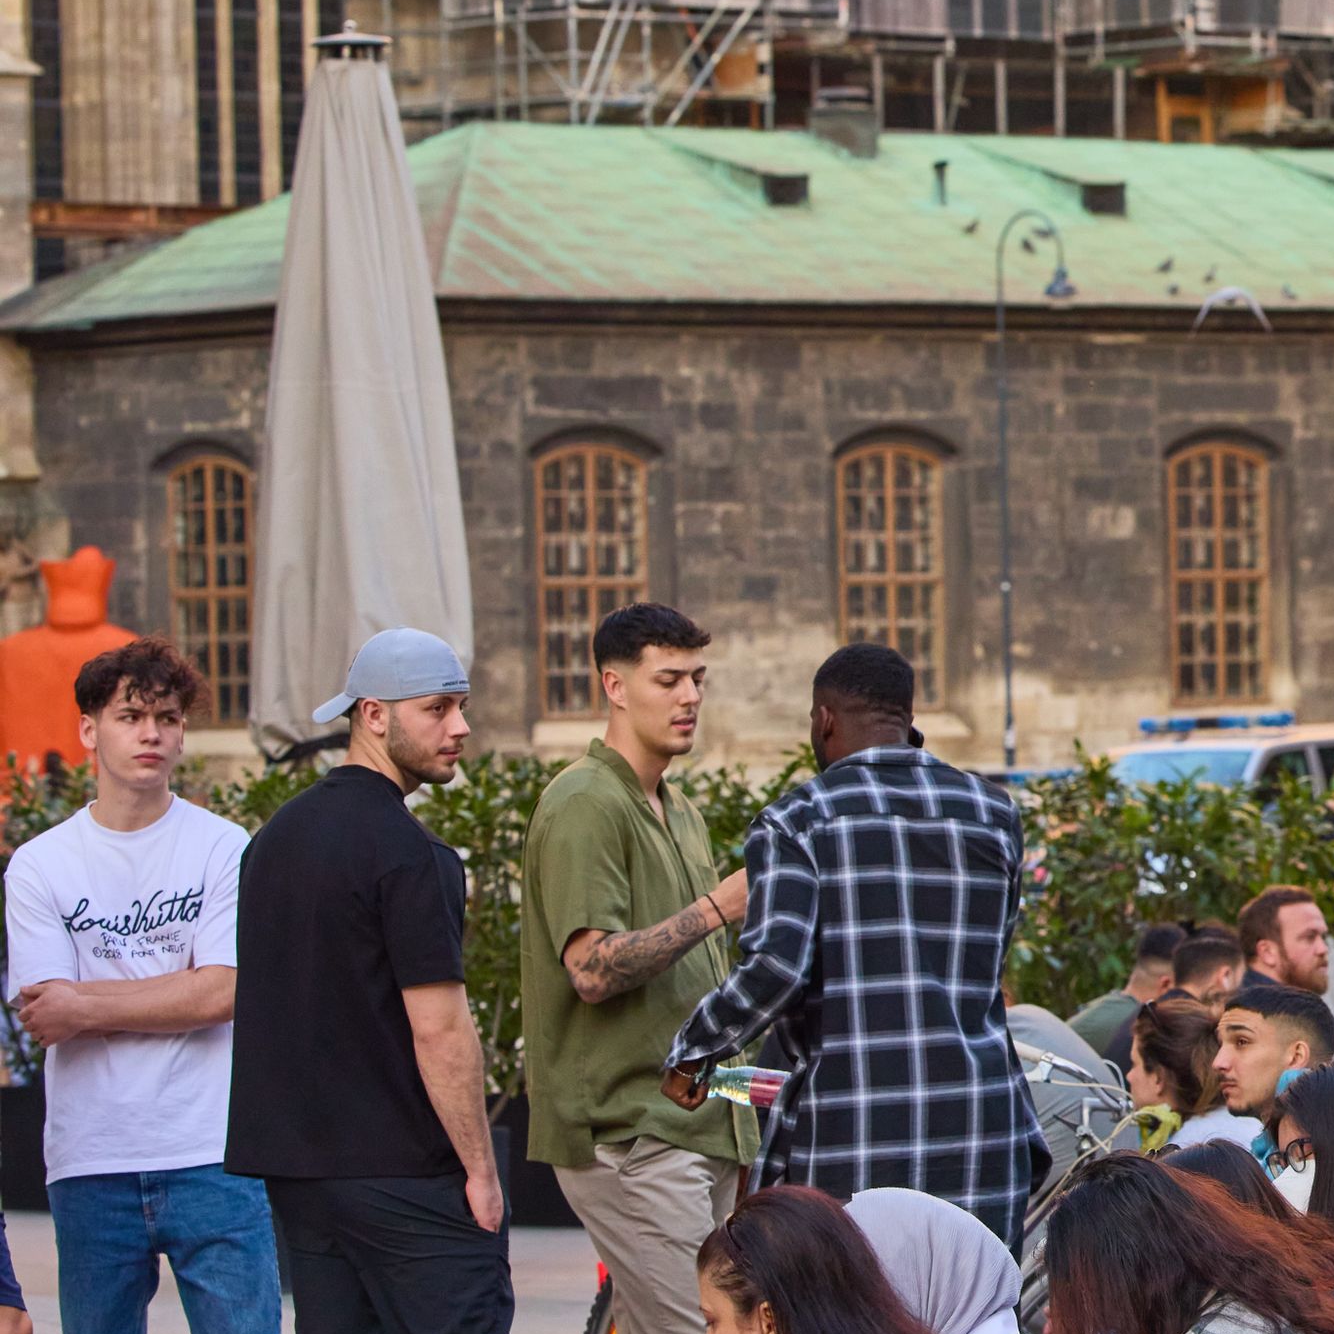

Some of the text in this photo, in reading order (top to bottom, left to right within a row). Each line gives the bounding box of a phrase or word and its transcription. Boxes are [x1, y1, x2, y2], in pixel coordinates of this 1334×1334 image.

[61, 898, 131, 936] Louis
[137, 929, 182, 947] FRANCE
[161, 942, 187, 955] NEUF
